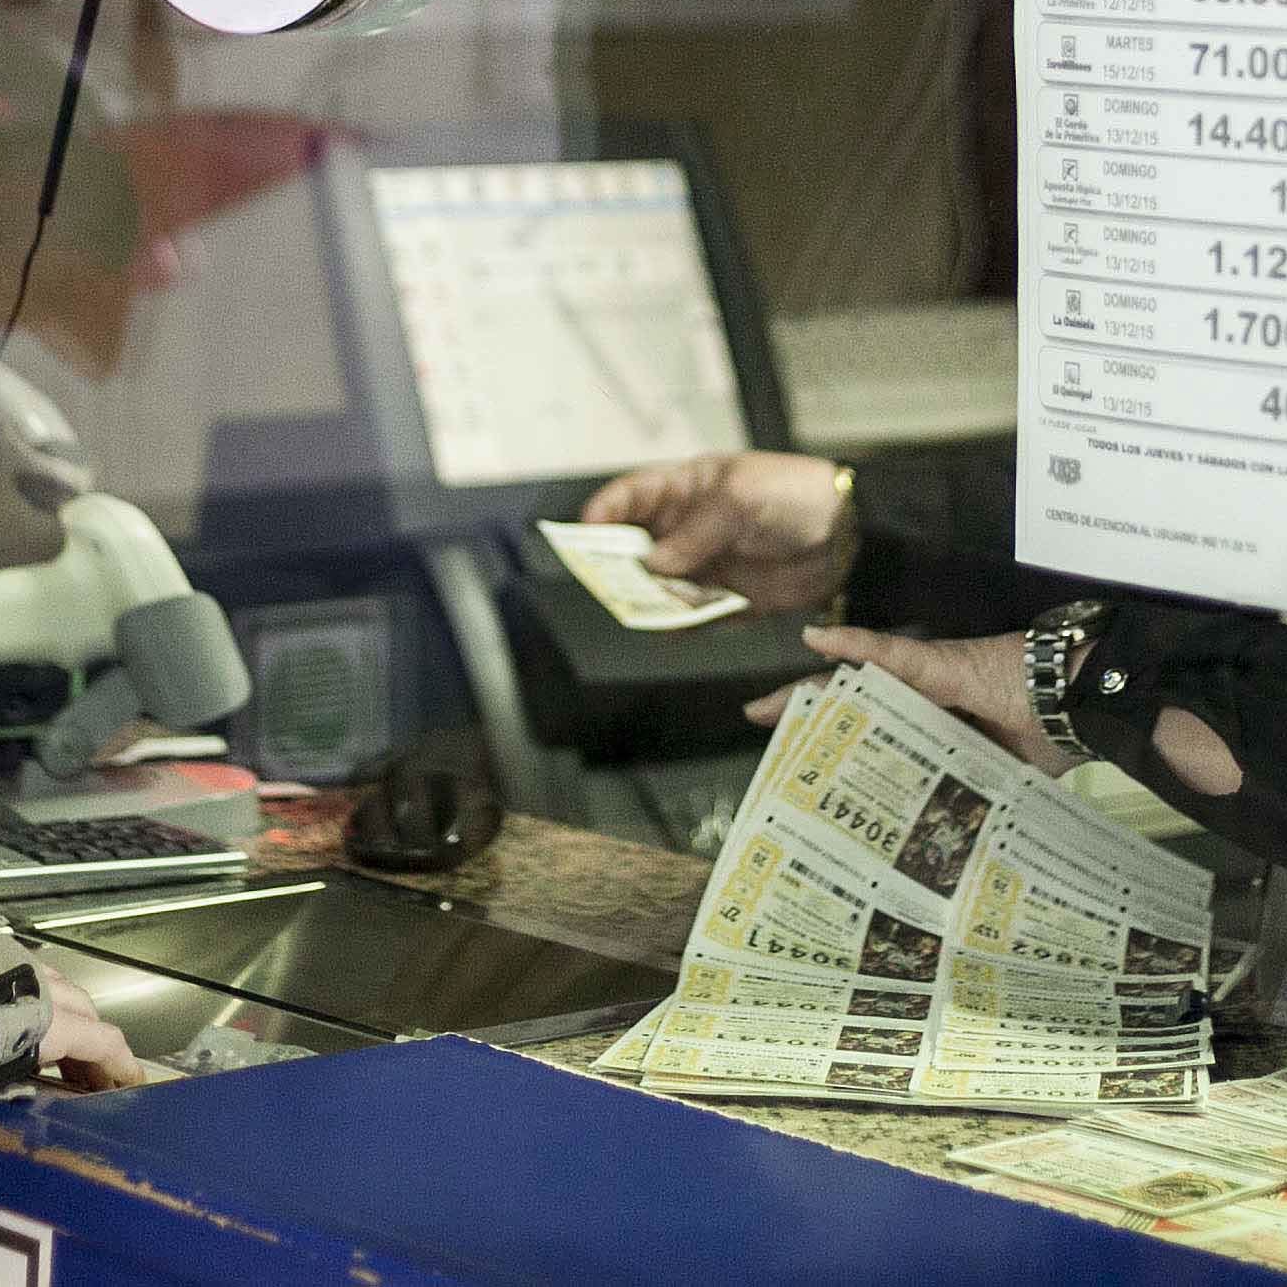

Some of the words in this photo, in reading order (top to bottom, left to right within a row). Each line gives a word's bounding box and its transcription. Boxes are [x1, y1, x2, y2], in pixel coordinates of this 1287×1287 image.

[1104, 34, 1155, 53] MARTES
[1102, 64, 1155, 83] 15/12/15
[1103, 98, 1159, 117] DOMINGO
[1105, 128, 1159, 147] 13/12/15
[1102, 160, 1158, 180] DOMINGO
[1104, 192, 1158, 211] 13/12/15
[1102, 224, 1158, 246] DOMINGO
[1103, 255, 1156, 275] 13/12/15
[1102, 292, 1158, 313] DOMINGO
[1103, 319, 1155, 340] 13/12/15
[1102, 359, 1157, 382] DOMINGO
[1101, 395, 1153, 418] 13/12/15
[1087, 437, 1120, 453] TODOS
[1122, 442, 1142, 457] LOS
[1144, 445, 1185, 463] JUEVES
[1187, 450, 1194, 462] Y
[1251, 459, 1274, 475] CON
[1045, 507, 1079, 527] CENTRO
[1080, 514, 1091, 529] DE
[818, 788, 902, 854] 30441
